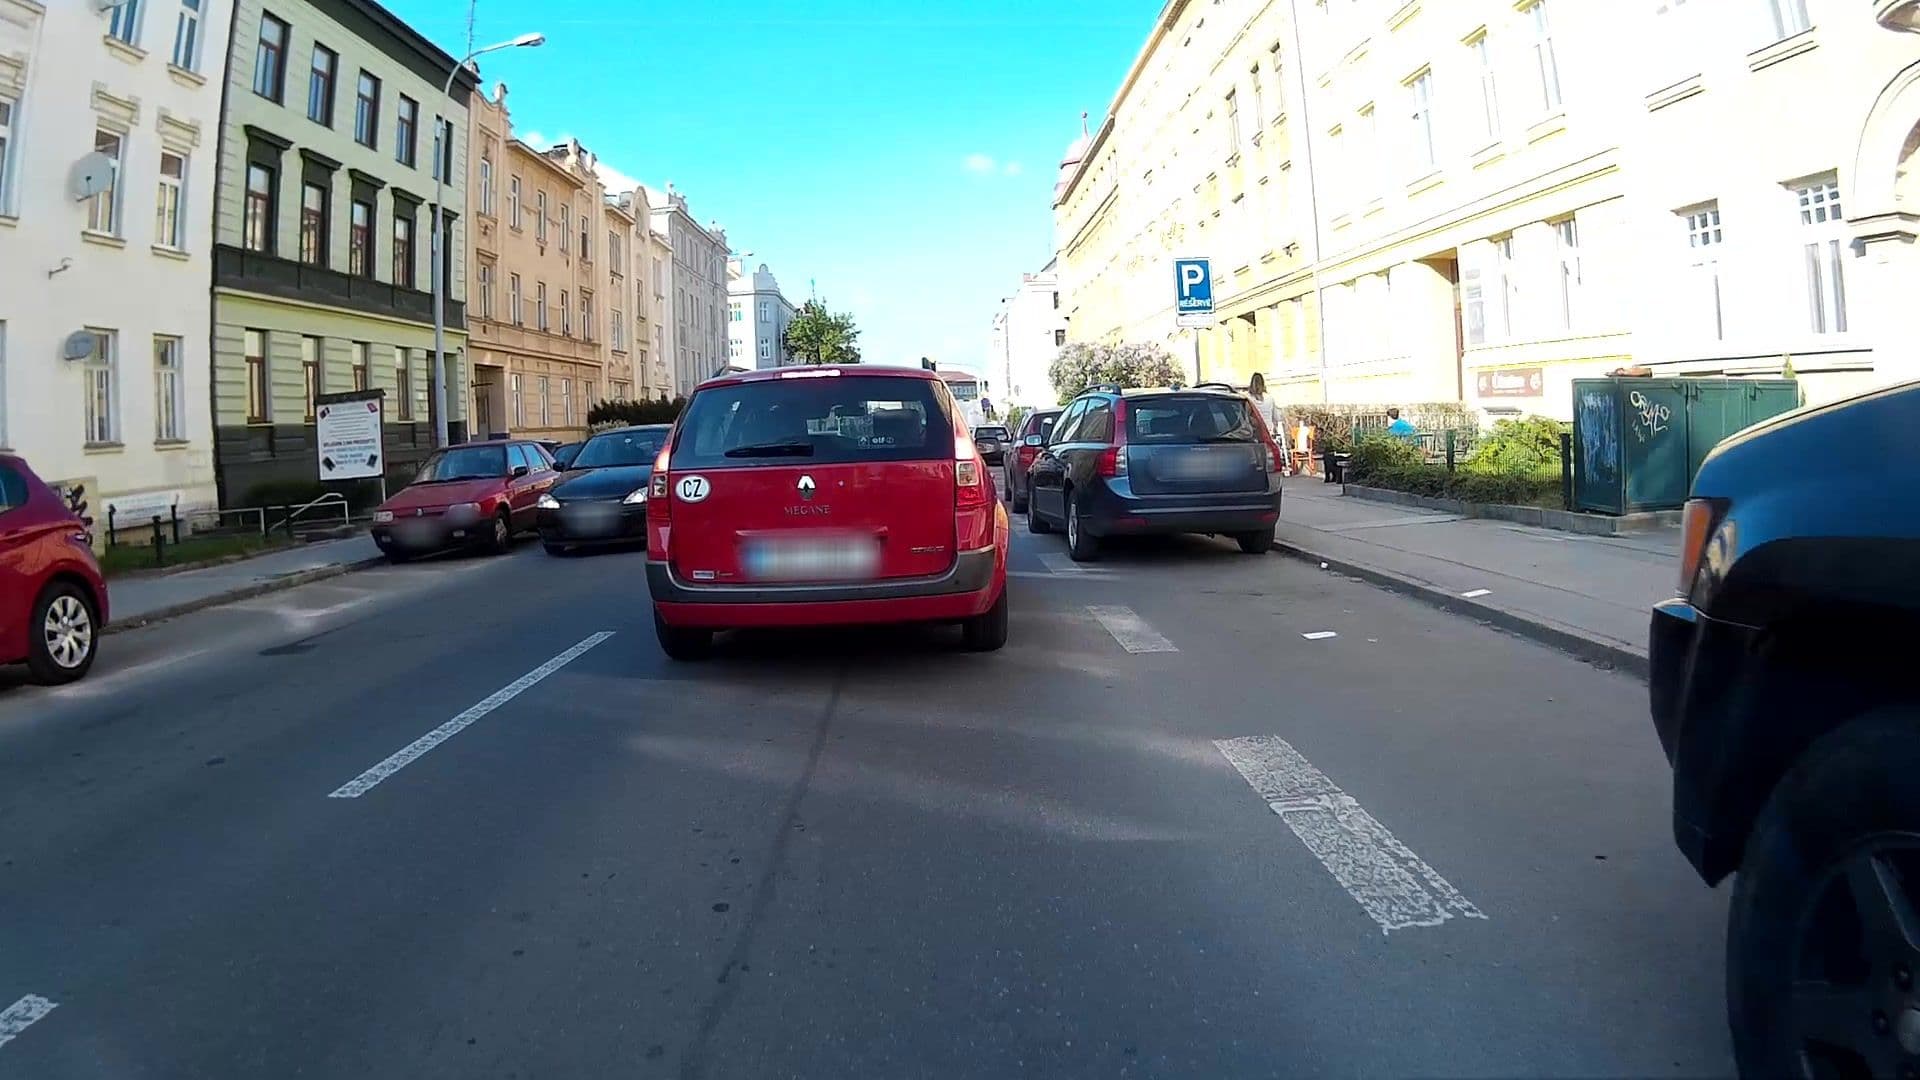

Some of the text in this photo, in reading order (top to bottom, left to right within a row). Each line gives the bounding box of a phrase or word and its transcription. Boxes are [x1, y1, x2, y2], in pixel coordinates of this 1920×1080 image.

[1181, 264, 1204, 297] P
[683, 479, 702, 498] CZ
[784, 504, 831, 516] MEGANE
